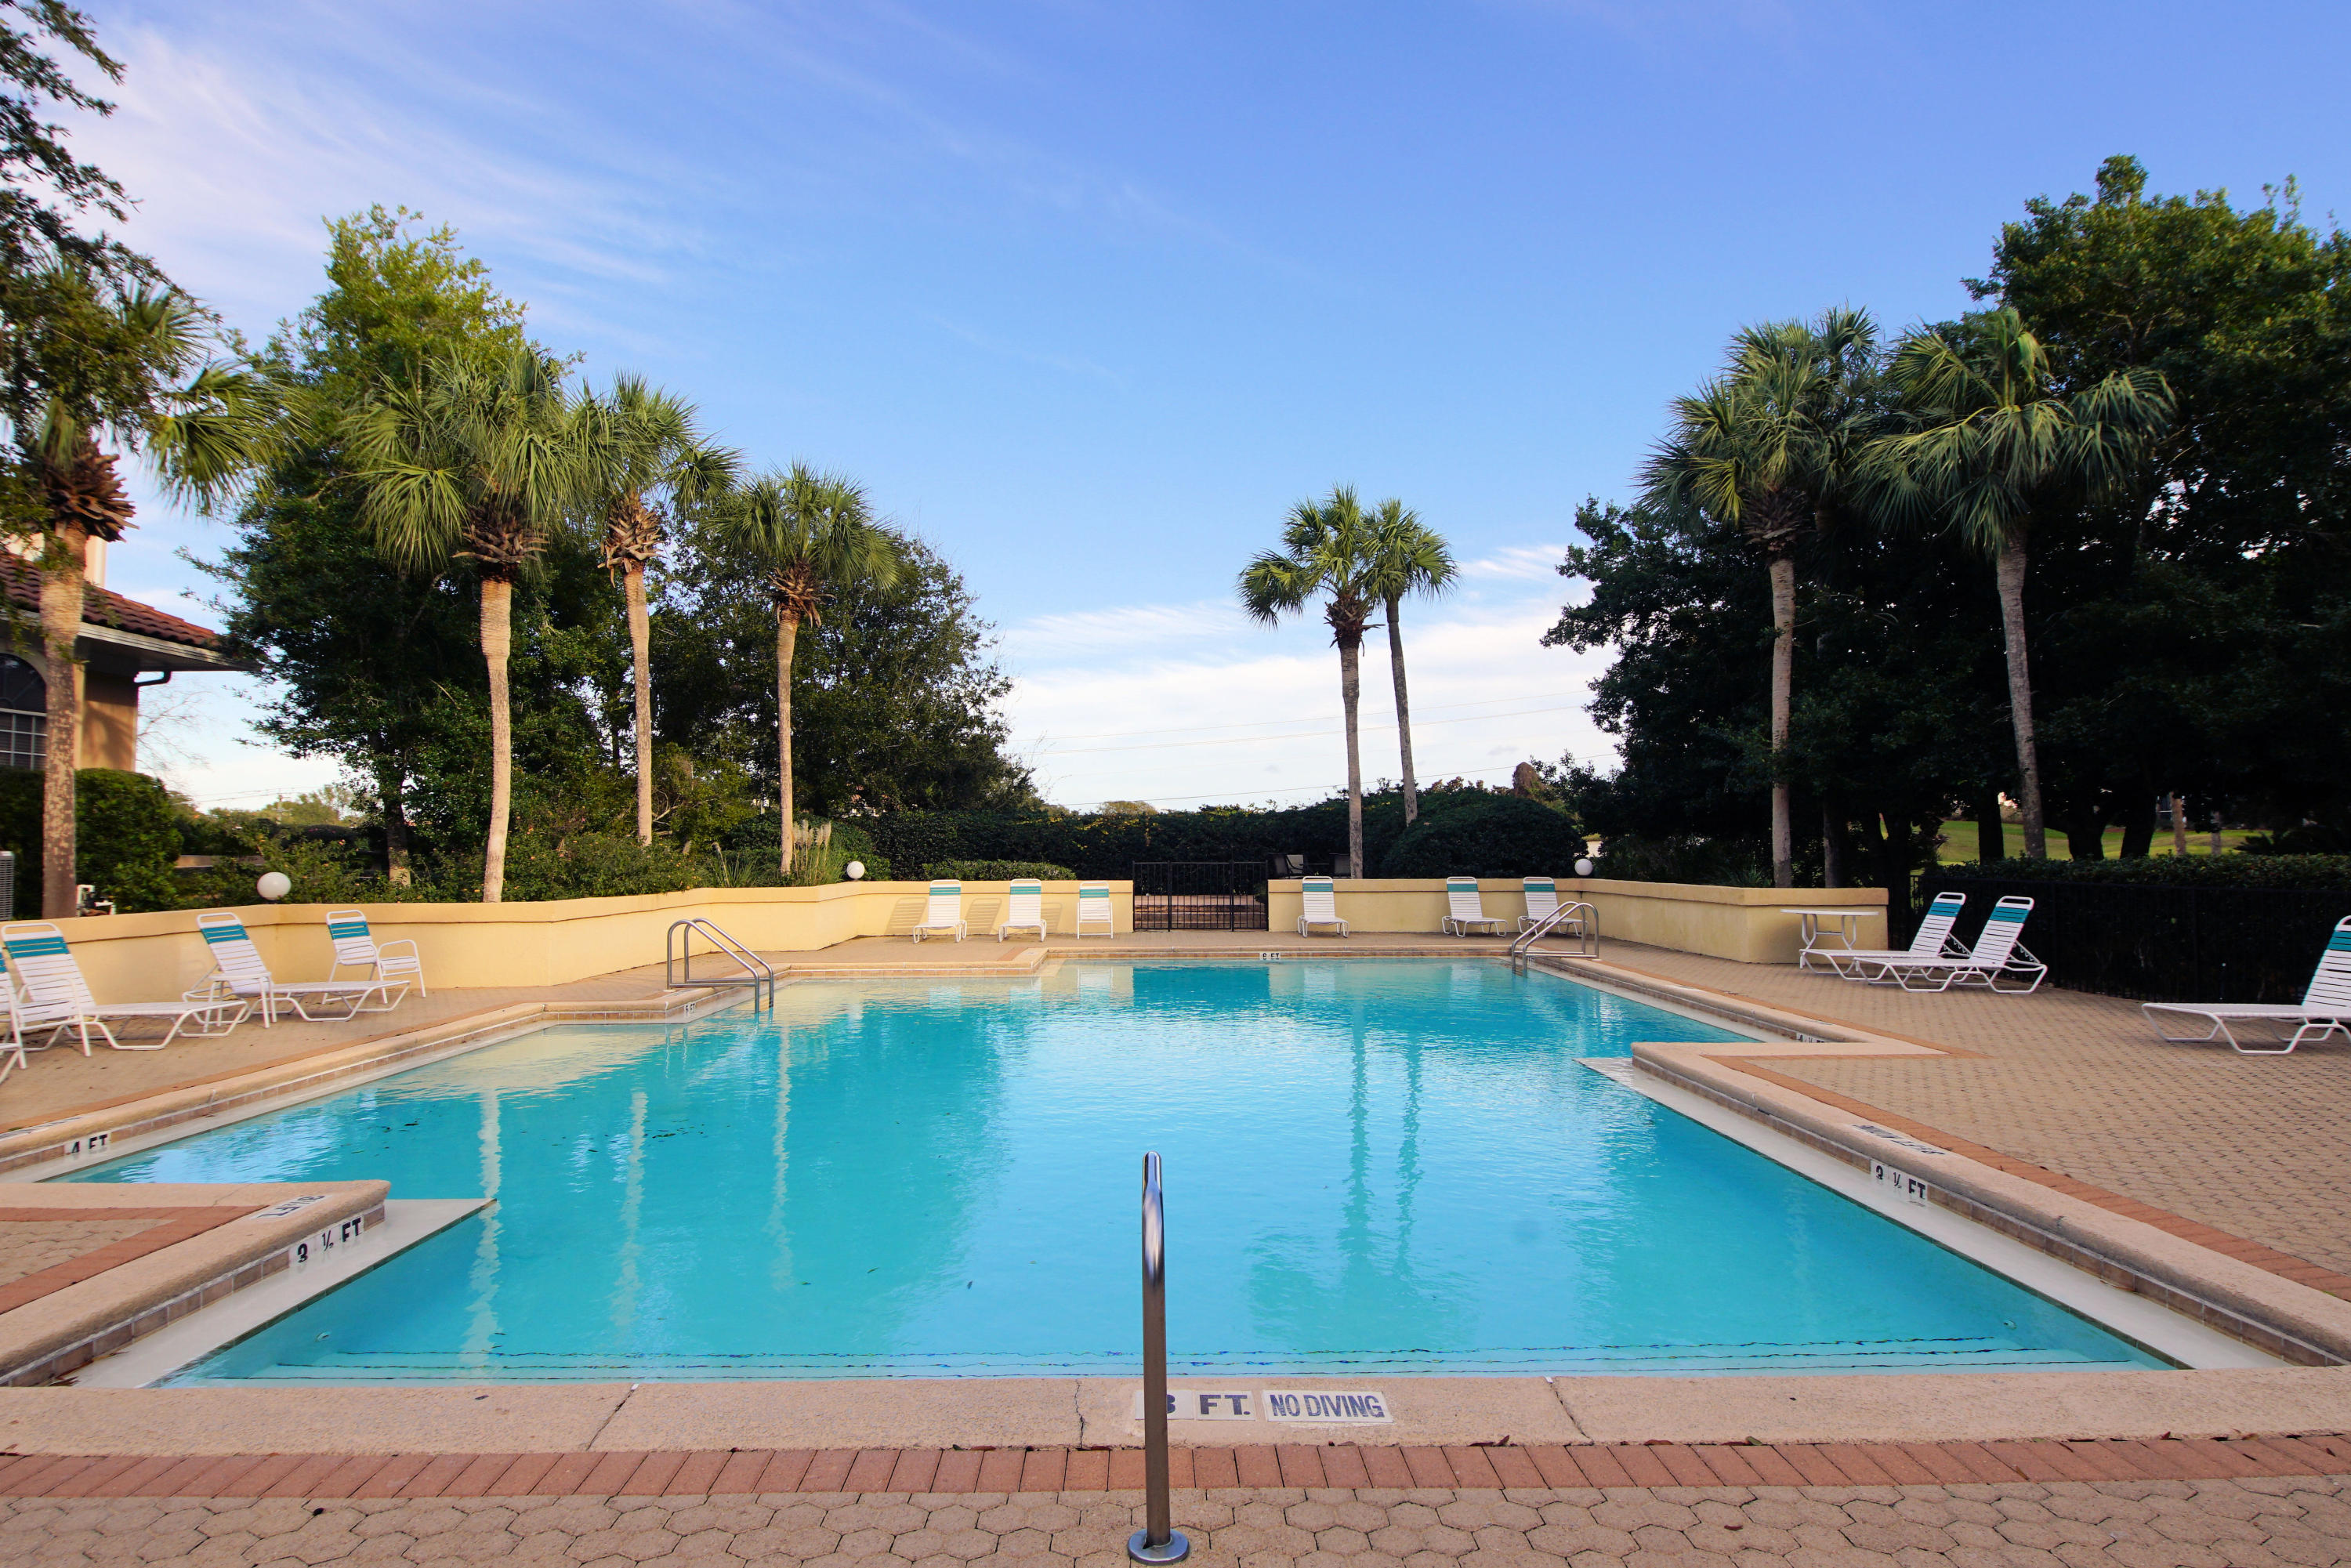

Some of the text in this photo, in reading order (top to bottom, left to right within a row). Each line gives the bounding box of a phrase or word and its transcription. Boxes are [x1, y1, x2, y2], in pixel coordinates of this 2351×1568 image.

[88, 1134, 108, 1150] FT
[1908, 1179, 1925, 1198] FT
[297, 1243, 309, 1263] 3
[341, 1218, 361, 1243] FT
[1270, 1394, 1386, 1418] NO DIVING
